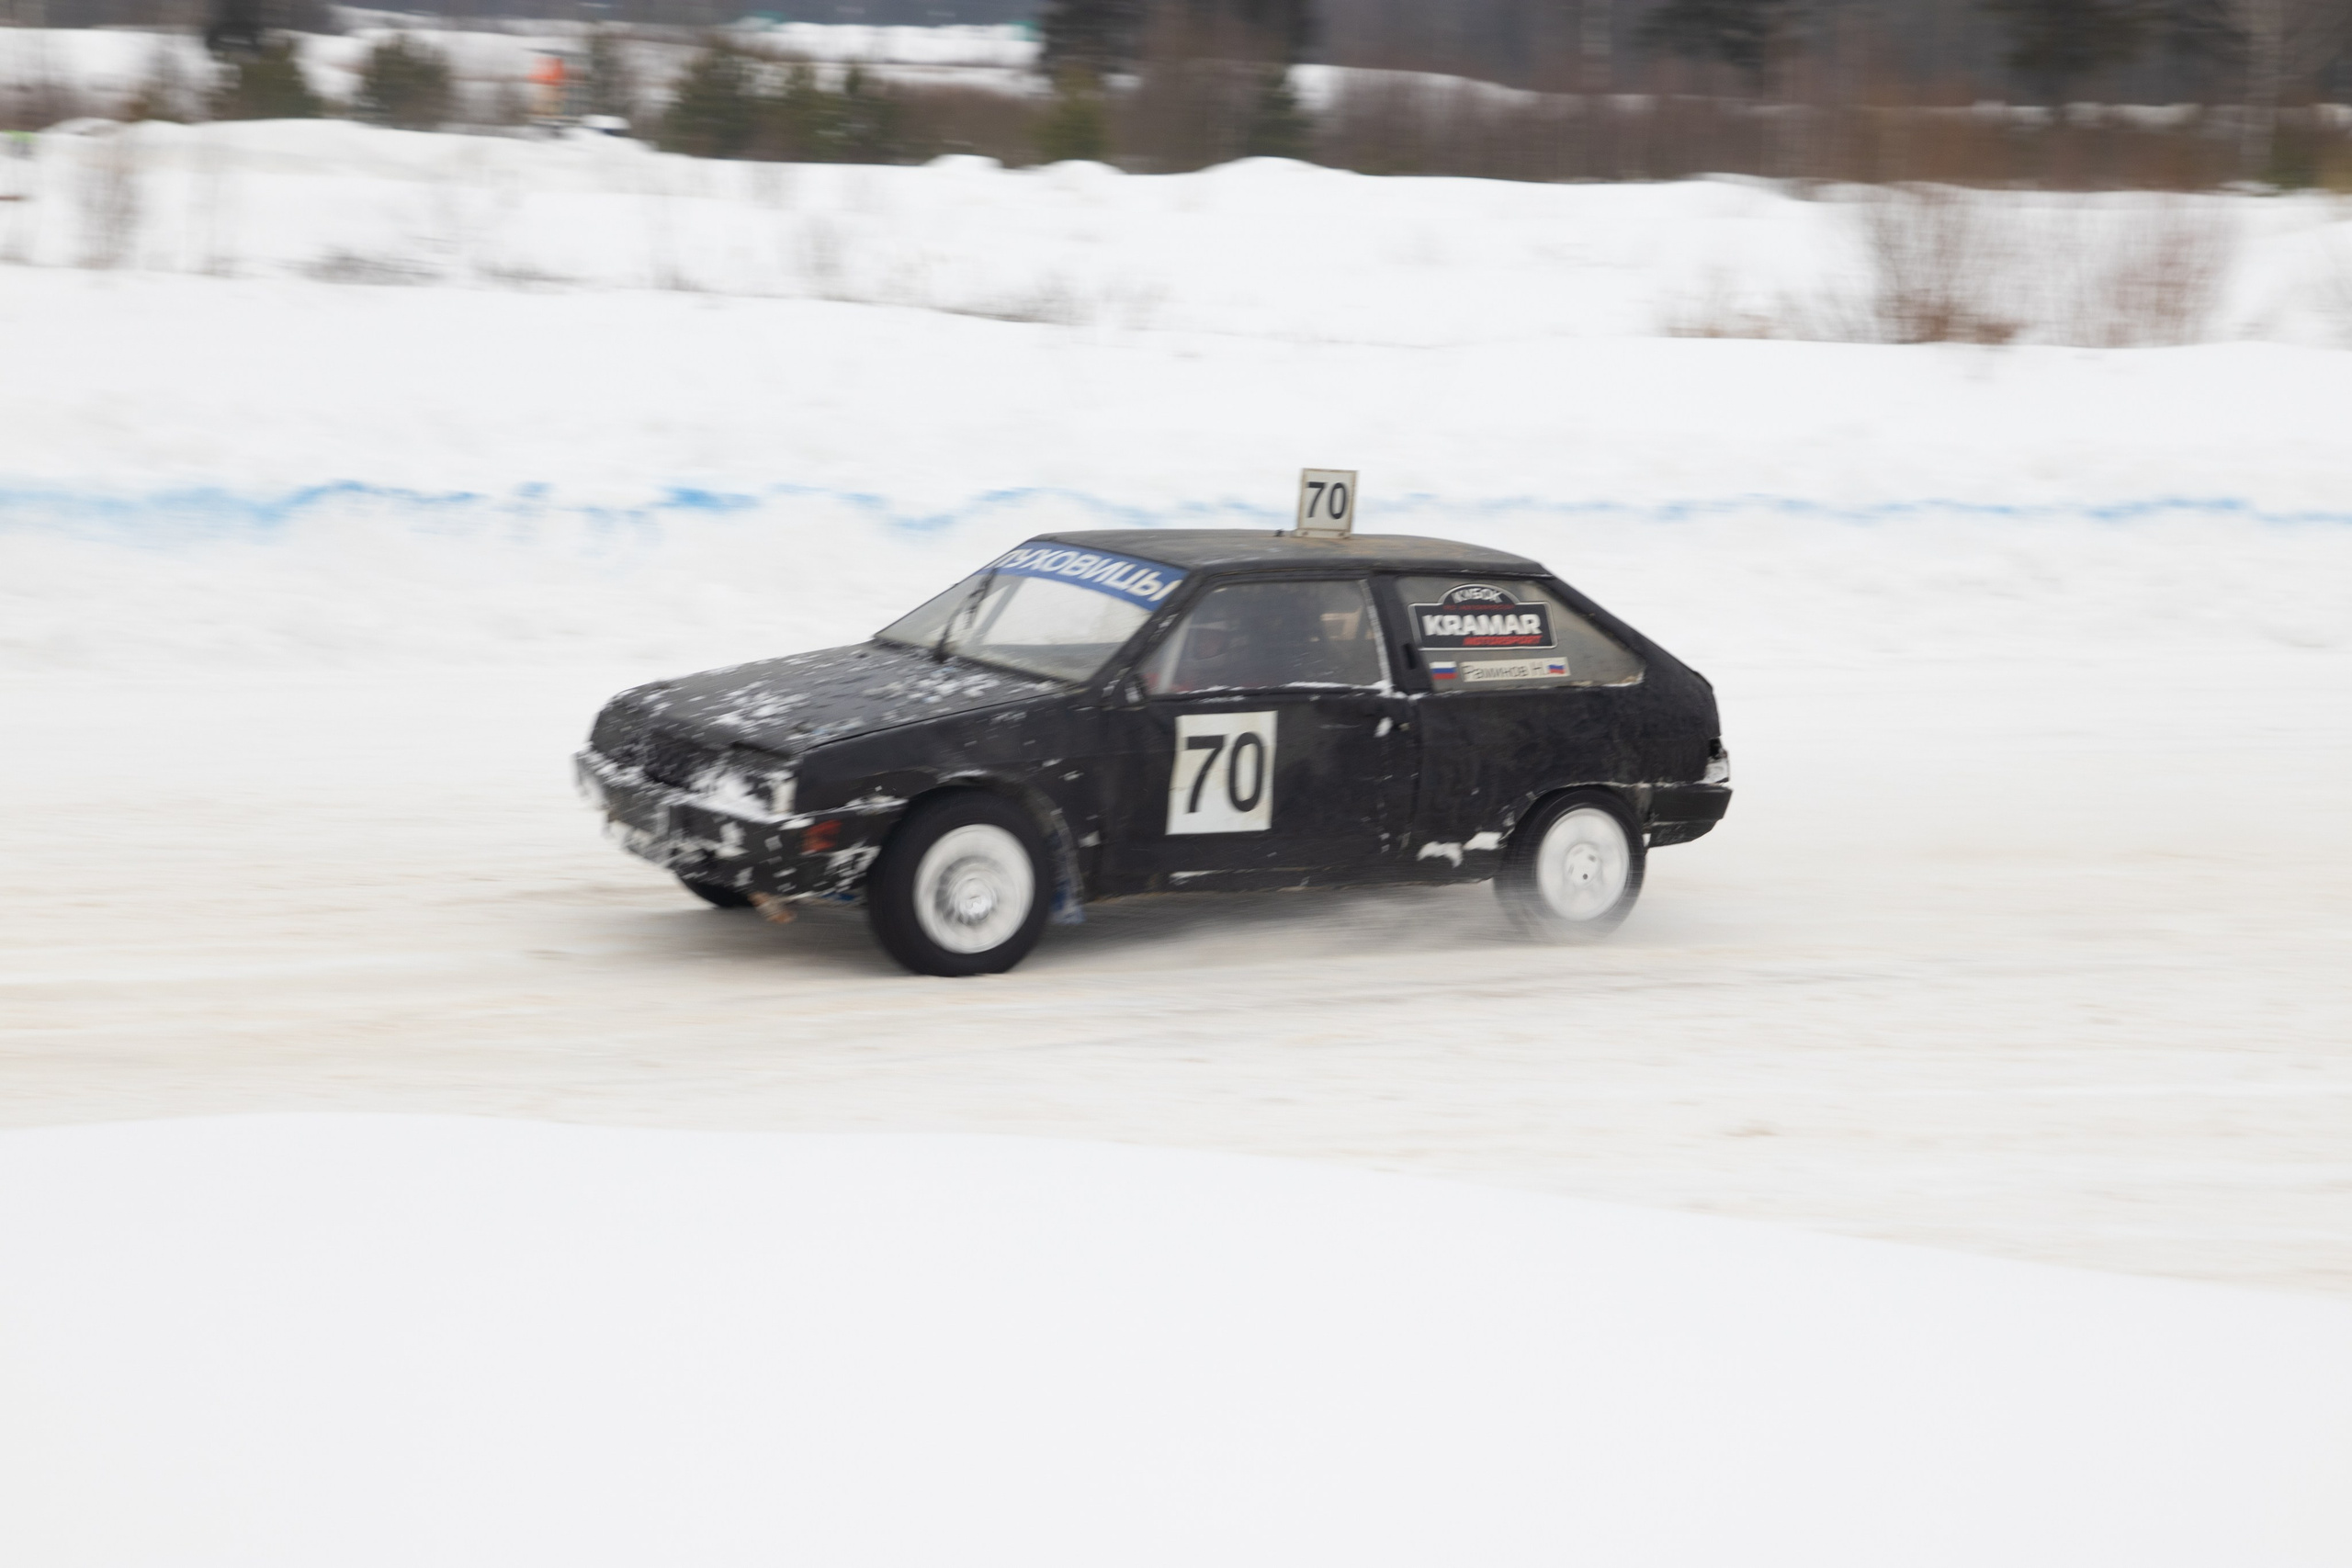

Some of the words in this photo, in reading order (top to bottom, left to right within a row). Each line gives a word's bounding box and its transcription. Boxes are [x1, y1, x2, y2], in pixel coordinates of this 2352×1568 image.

[1306, 481, 1348, 520] 70
[1422, 614, 1543, 636] KRAMAR
[1184, 731, 1265, 814] 70
